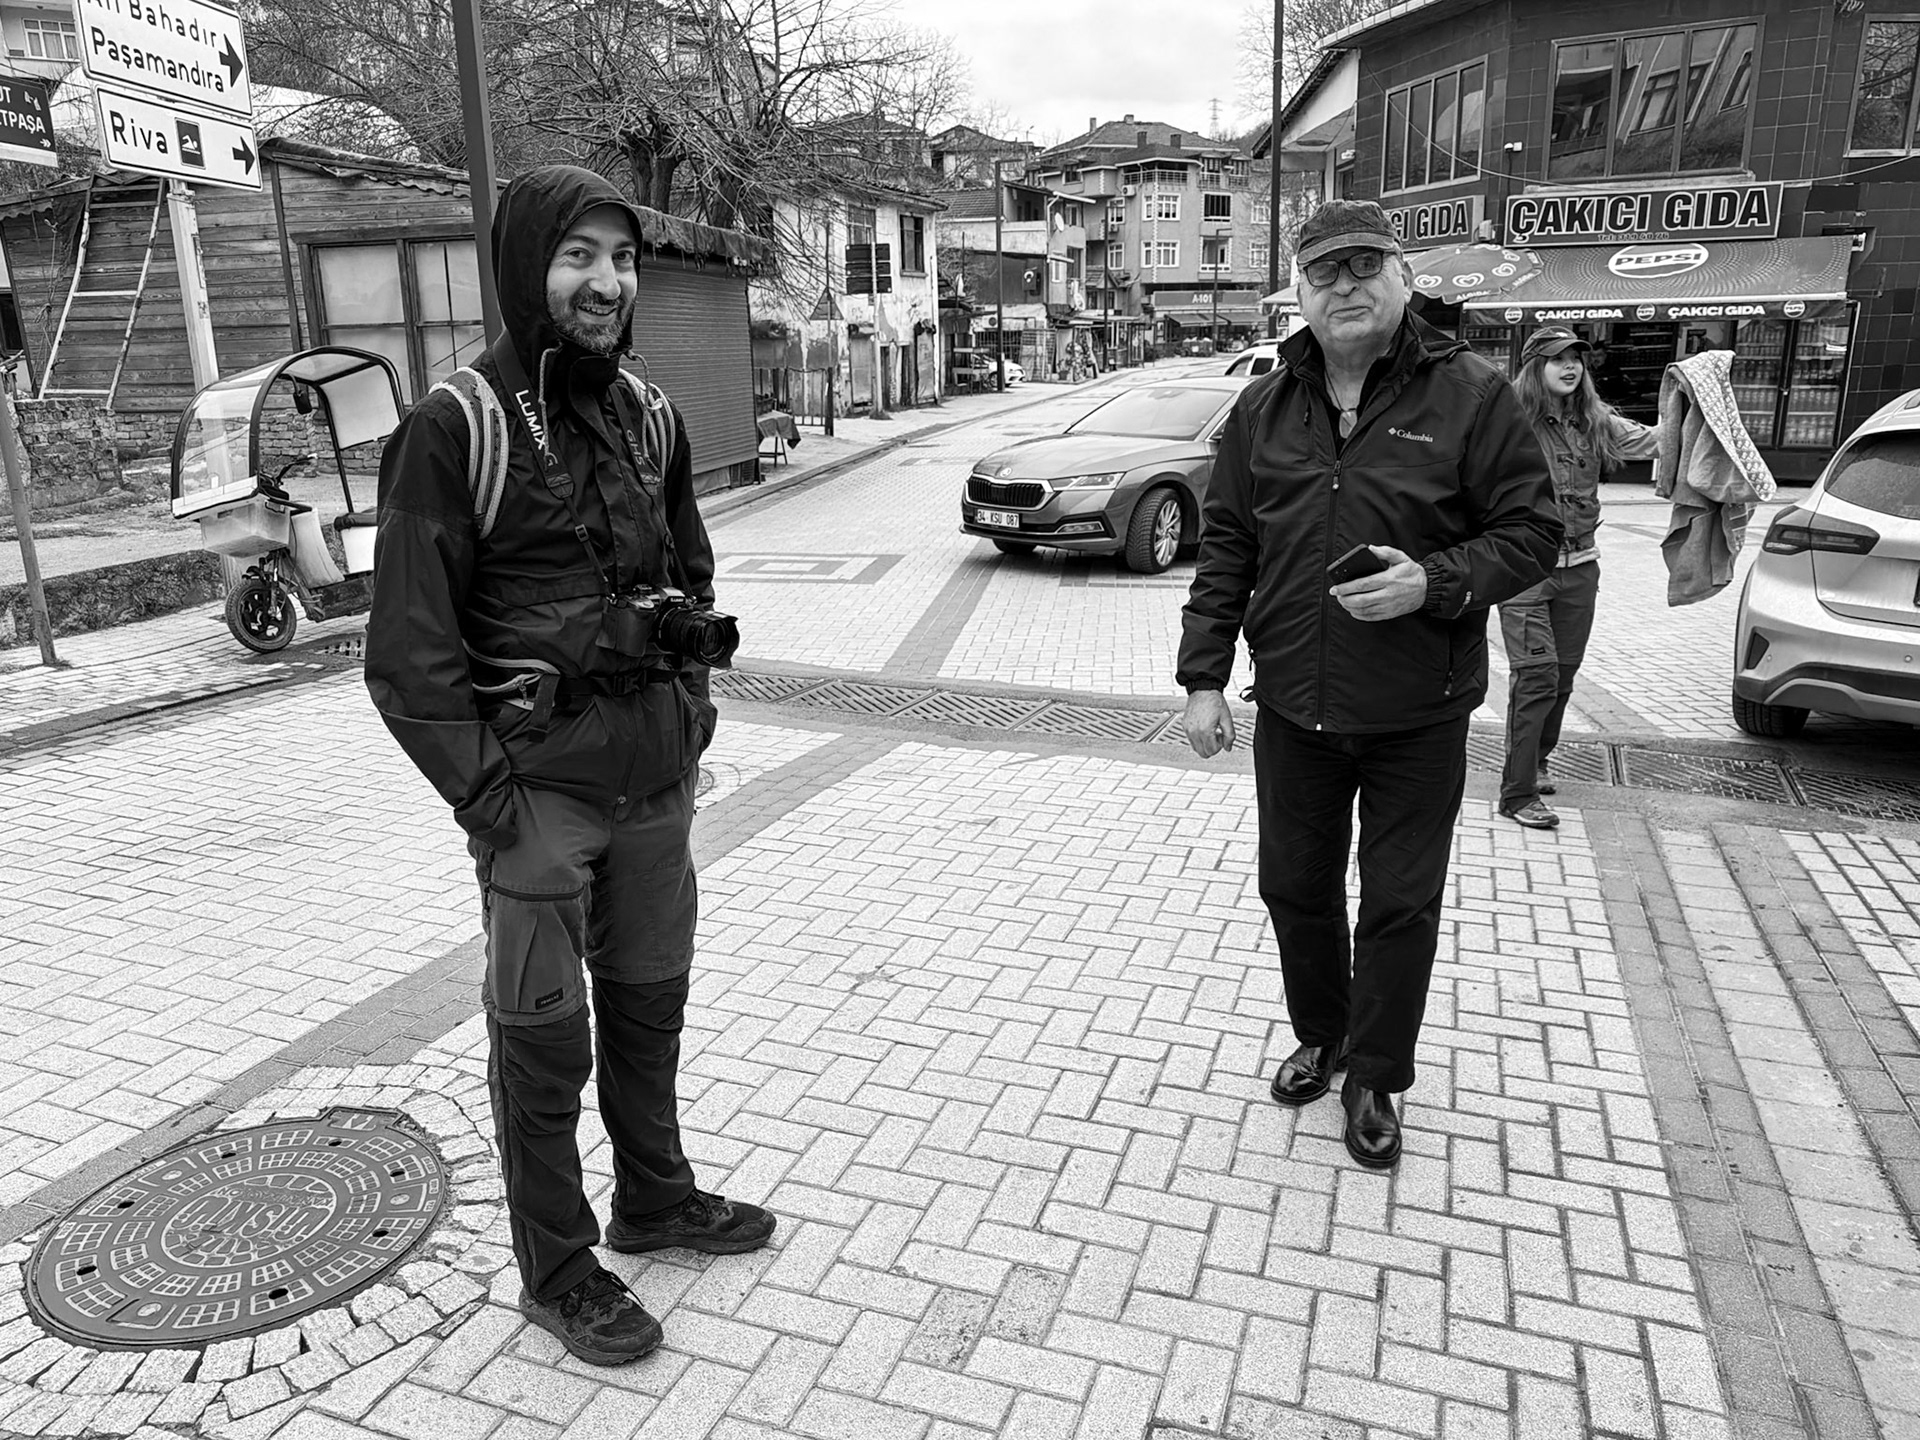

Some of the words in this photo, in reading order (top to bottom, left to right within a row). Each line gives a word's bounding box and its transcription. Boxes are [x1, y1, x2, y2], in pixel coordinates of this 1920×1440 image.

[91, 26, 224, 92] Paşamandıra
[0, 109, 46, 134] TPAŞA
[110, 110, 168, 154] Riva
[1415, 201, 1468, 240] GIDA
[1510, 194, 1652, 243] ÇAKICI
[1662, 187, 1770, 230] GIDA
[1615, 253, 1701, 267] PEPSI
[1535, 309, 1584, 322] ÇAKICI
[1586, 308, 1624, 319] GIDA
[1667, 306, 1723, 319] ÇAKICI
[1724, 305, 1766, 316] GIDA
[515, 389, 545, 450] LUMIX
[1396, 429, 1433, 442] Columbia
[978, 511, 986, 521] 34
[1006, 514, 1018, 526] 087
